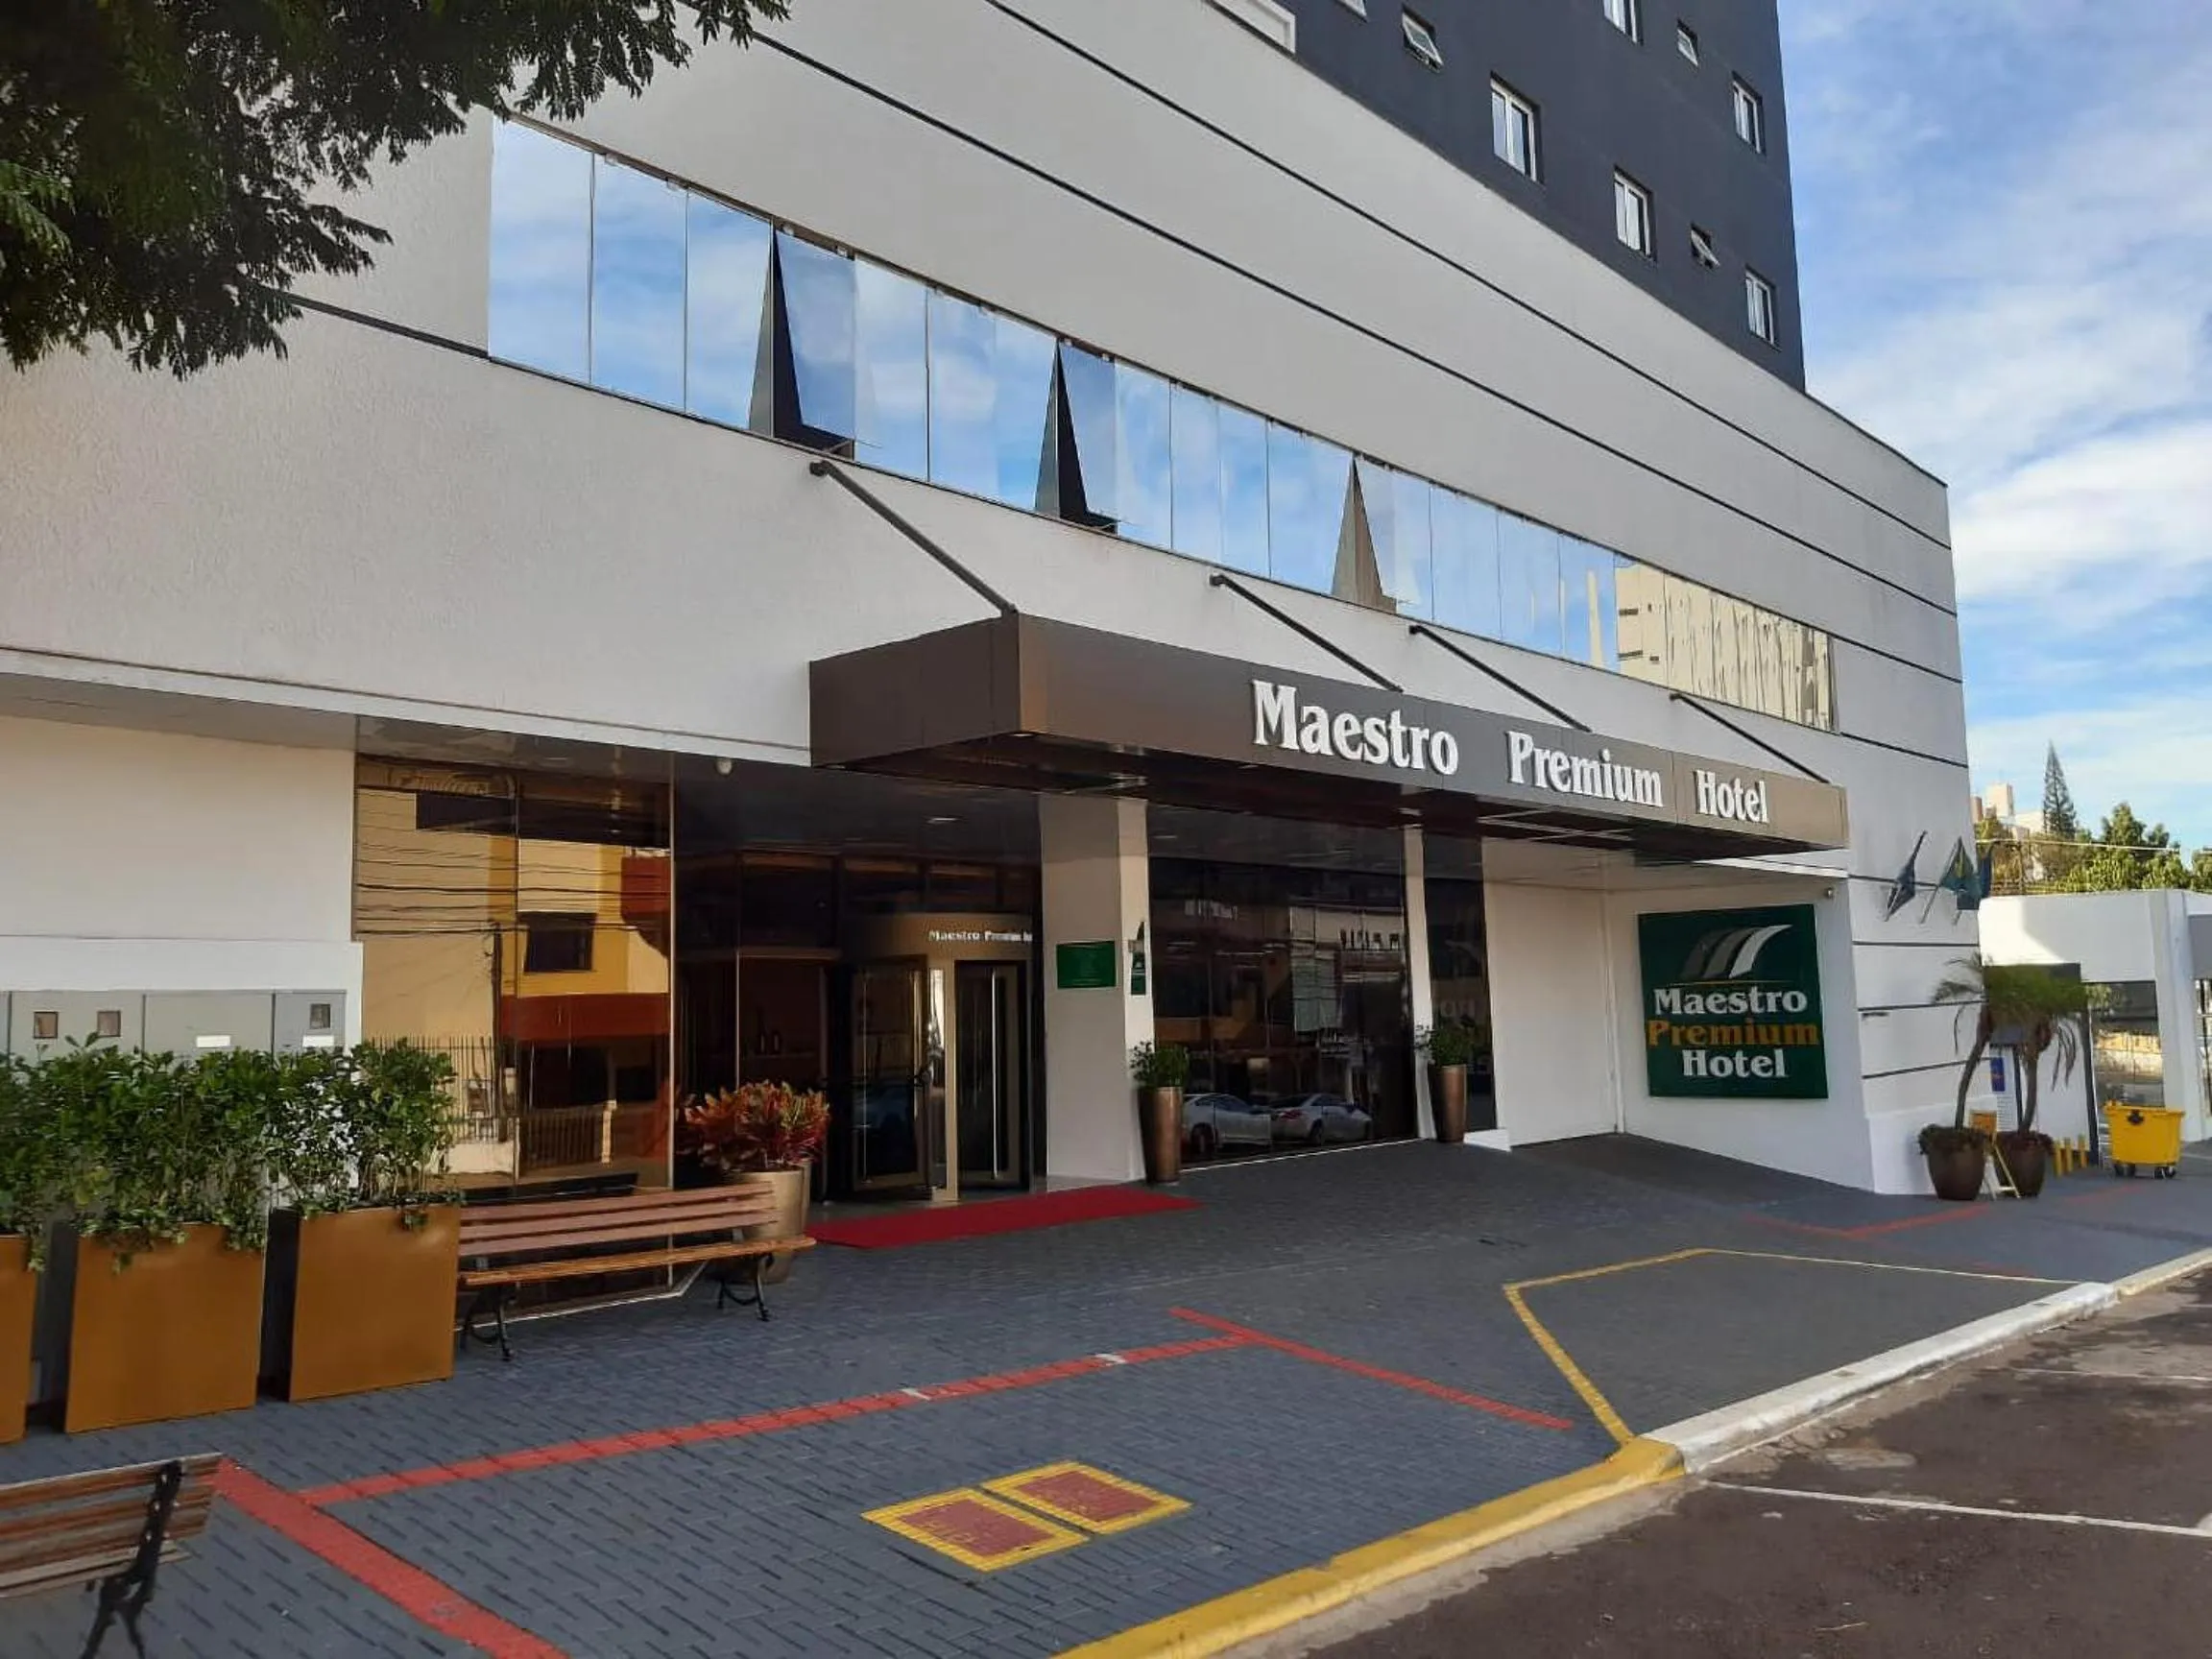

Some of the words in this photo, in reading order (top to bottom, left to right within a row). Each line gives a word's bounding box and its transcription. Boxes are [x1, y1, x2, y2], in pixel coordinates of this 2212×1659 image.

[1252, 679, 1459, 776] Maestro
[1506, 730, 1664, 807] Premium
[1694, 769, 1769, 823] Hotel
[1653, 985, 1808, 1015] Maestro
[1647, 1018, 1819, 1046] Premium
[1682, 1047, 1788, 1078] Hotel
